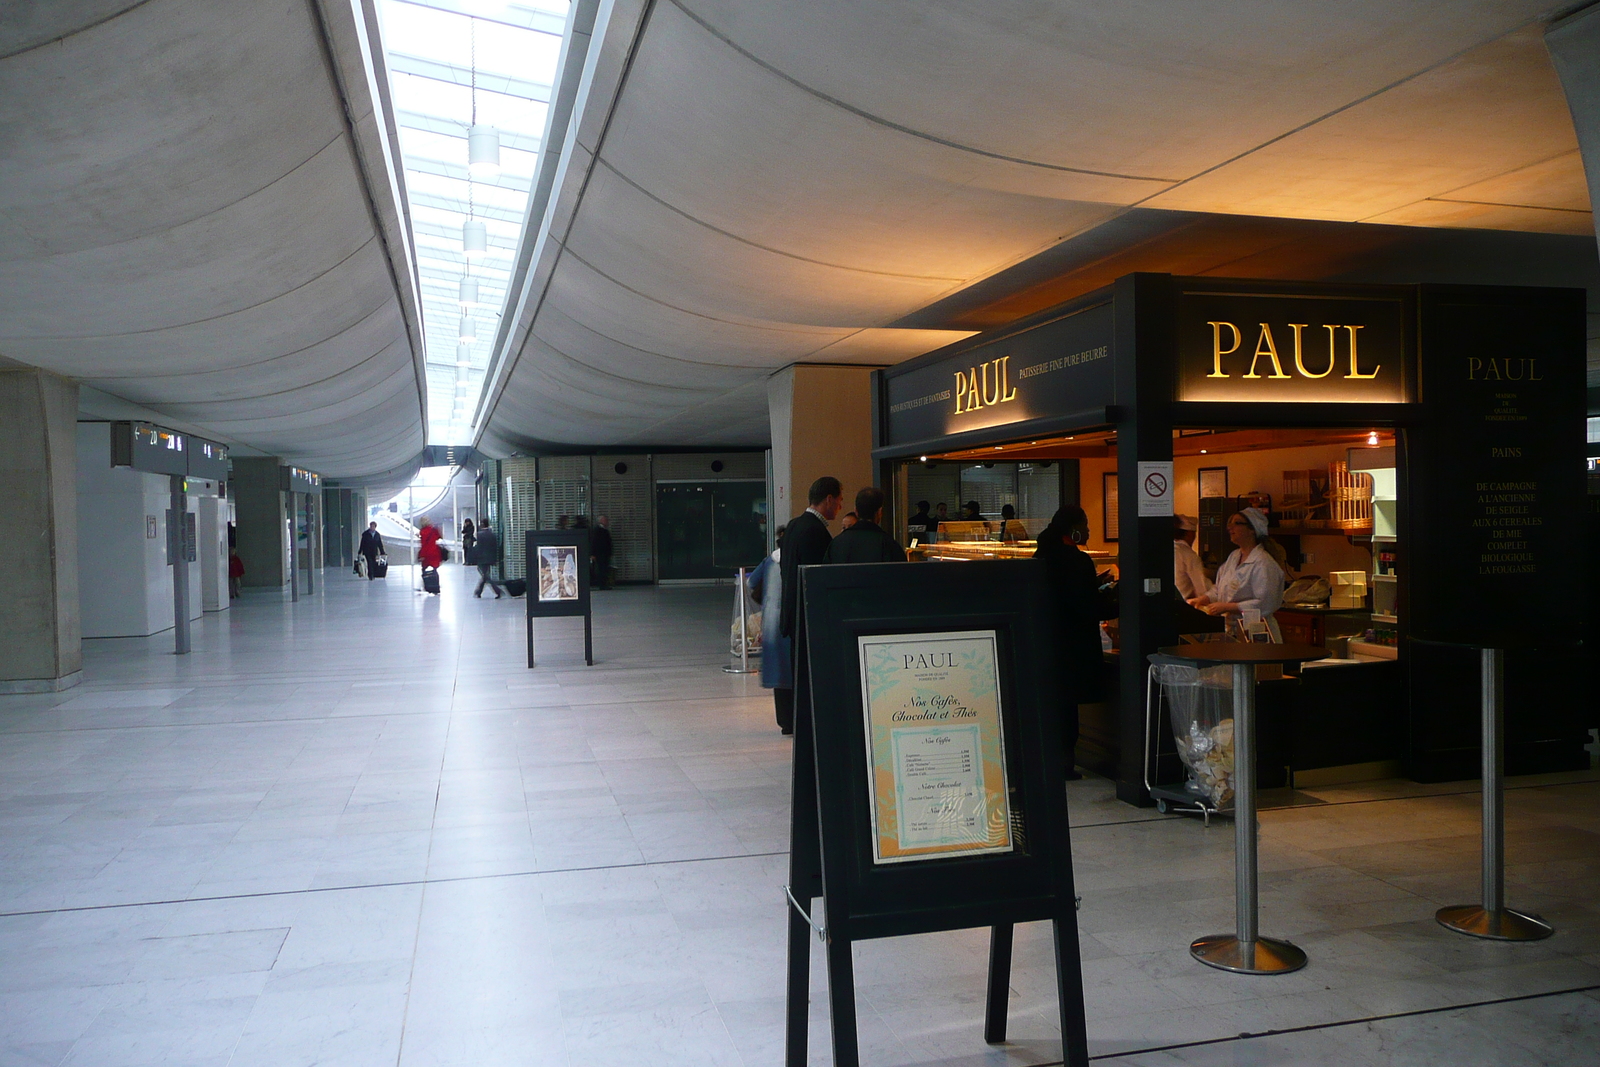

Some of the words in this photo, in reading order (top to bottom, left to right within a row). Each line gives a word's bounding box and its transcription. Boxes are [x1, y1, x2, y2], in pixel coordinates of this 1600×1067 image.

[1206, 321, 1380, 379] PAUL
[1019, 362, 1049, 379] PATISSERIE
[1049, 358, 1063, 371] FINE
[1063, 353, 1080, 367] PURE
[1080, 346, 1107, 363] BEURRE
[1467, 357, 1545, 381] PAUL
[954, 356, 1017, 415] PAUL
[1491, 447, 1522, 458] PAINS
[1476, 482, 1488, 491] DE
[1490, 481, 1537, 491] CAMPAGNE
[1477, 495, 1485, 503] A
[1485, 494, 1536, 503] L'ANCIENNE
[1485, 506, 1498, 515] DE
[1499, 505, 1529, 514] SEIGLE
[1472, 518, 1491, 527] AUX
[1492, 518, 1498, 526] 6
[1499, 517, 1542, 526] CEREALES
[1492, 530, 1504, 539] DE
[1506, 529, 1522, 538] MIE
[1487, 541, 1528, 550] COMPLET
[1481, 552, 1534, 563] BIOLOGIQUE
[1479, 566, 1491, 574] LA
[1492, 564, 1536, 574] FOUGASSE
[903, 652, 960, 669] PAUL
[904, 696, 926, 708] Nos
[892, 709, 937, 722] Chocolat
[940, 711, 949, 719] et
[952, 707, 978, 718] Thés
[937, 780, 962, 789] Chocolat
